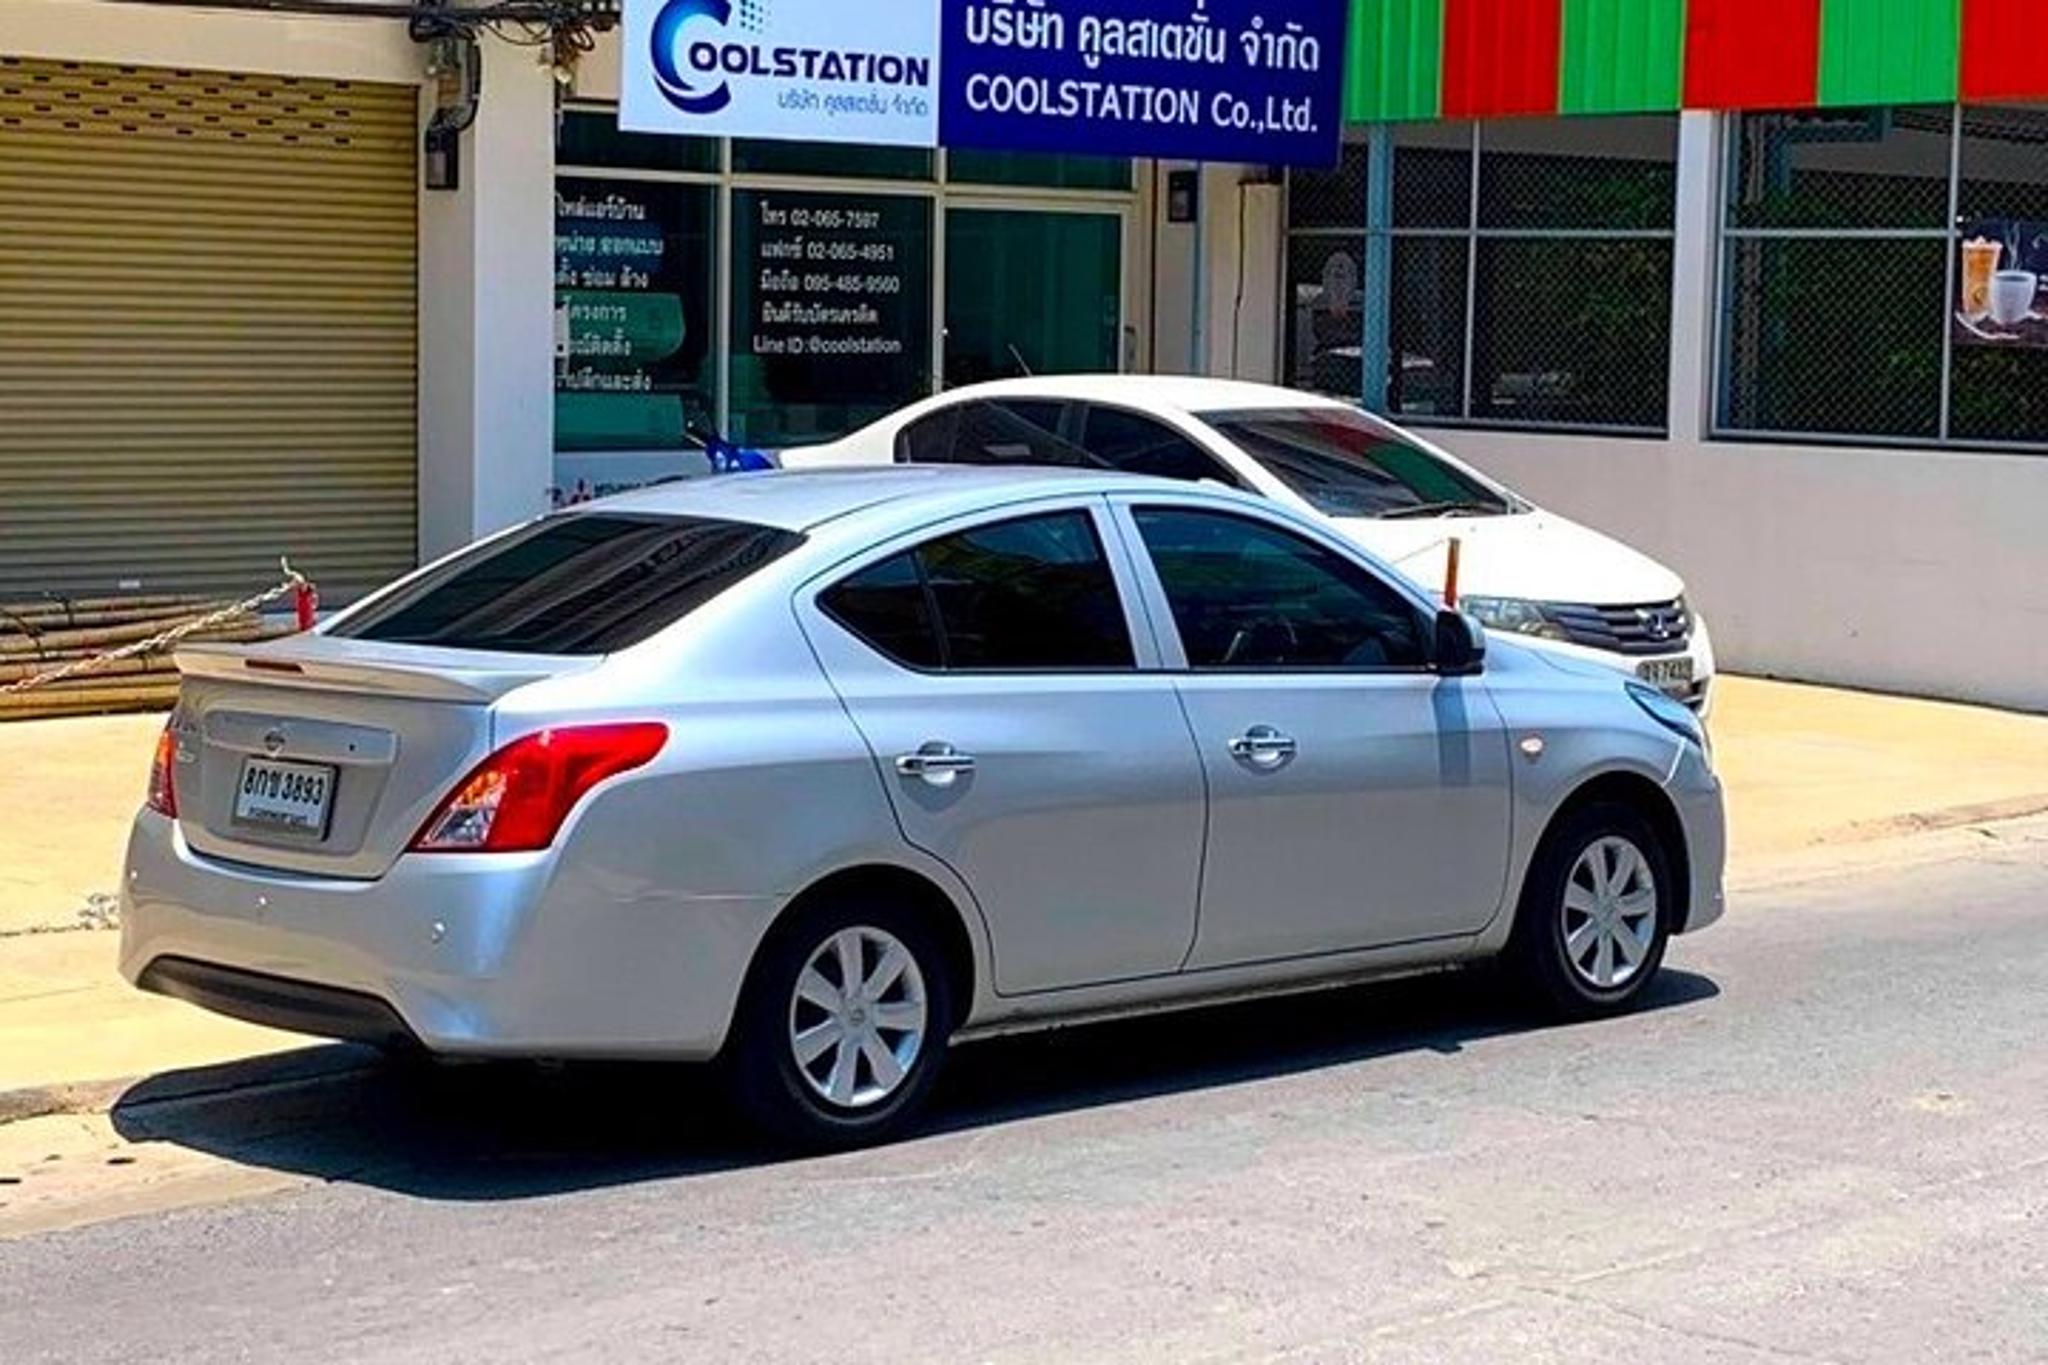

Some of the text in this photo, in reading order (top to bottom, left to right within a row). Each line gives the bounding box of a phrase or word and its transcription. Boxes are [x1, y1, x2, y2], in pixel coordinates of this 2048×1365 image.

[1239, 15, 1320, 71] จำกัด
[966, 73, 1318, 134] COOLSTATION Co.,Ltd.
[753, 335, 785, 353] Line
[281, 772, 324, 806] 3893
